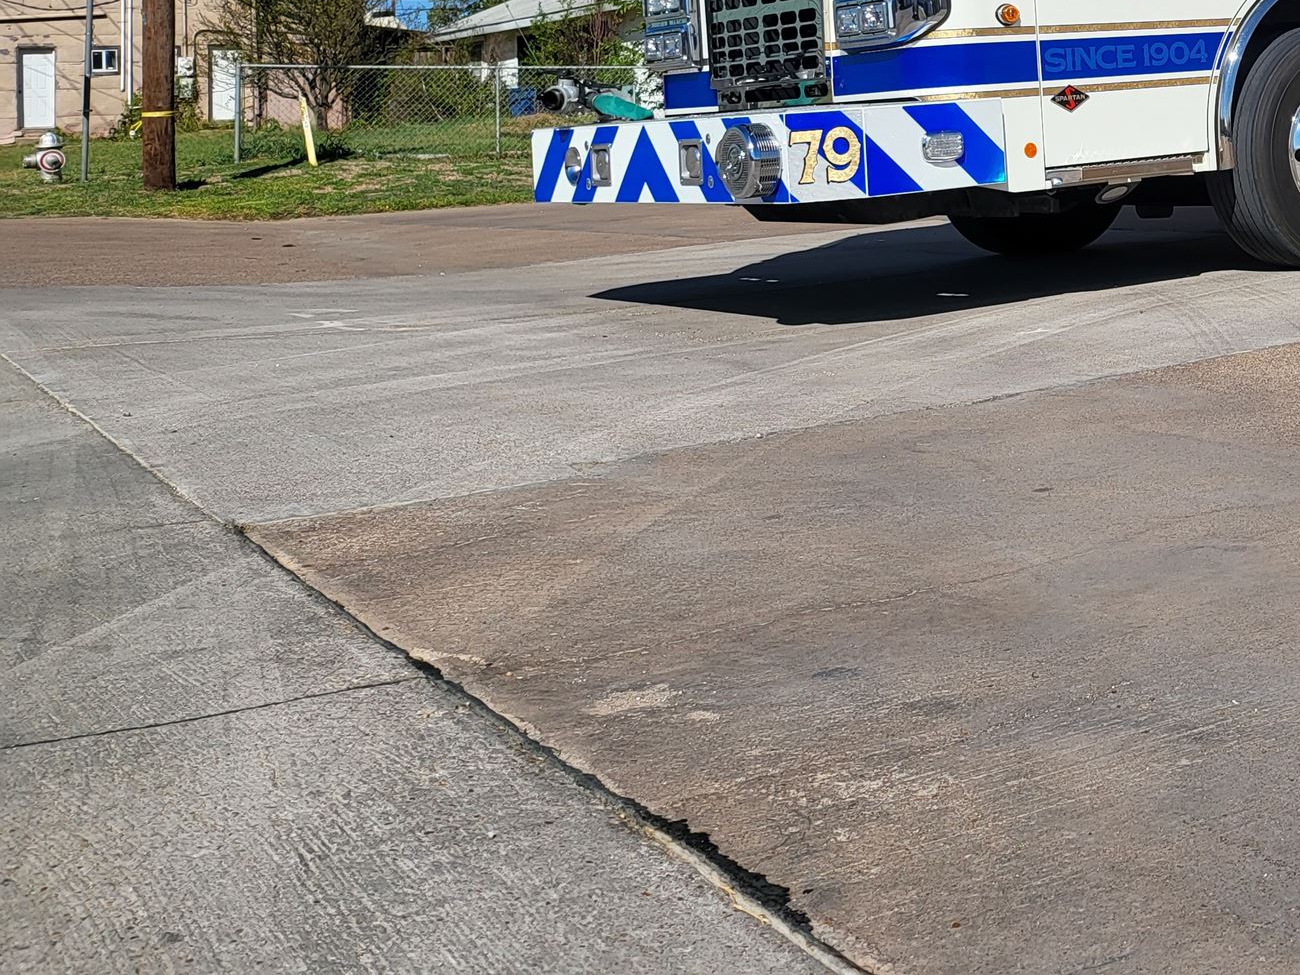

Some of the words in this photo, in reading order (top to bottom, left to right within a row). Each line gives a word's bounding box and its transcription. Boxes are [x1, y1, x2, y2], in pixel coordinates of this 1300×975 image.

[1044, 44, 1137, 73] SINCE
[1142, 39, 1208, 66] 1904
[1055, 94, 1086, 102] SPARTAN
[789, 126, 861, 184] 79
